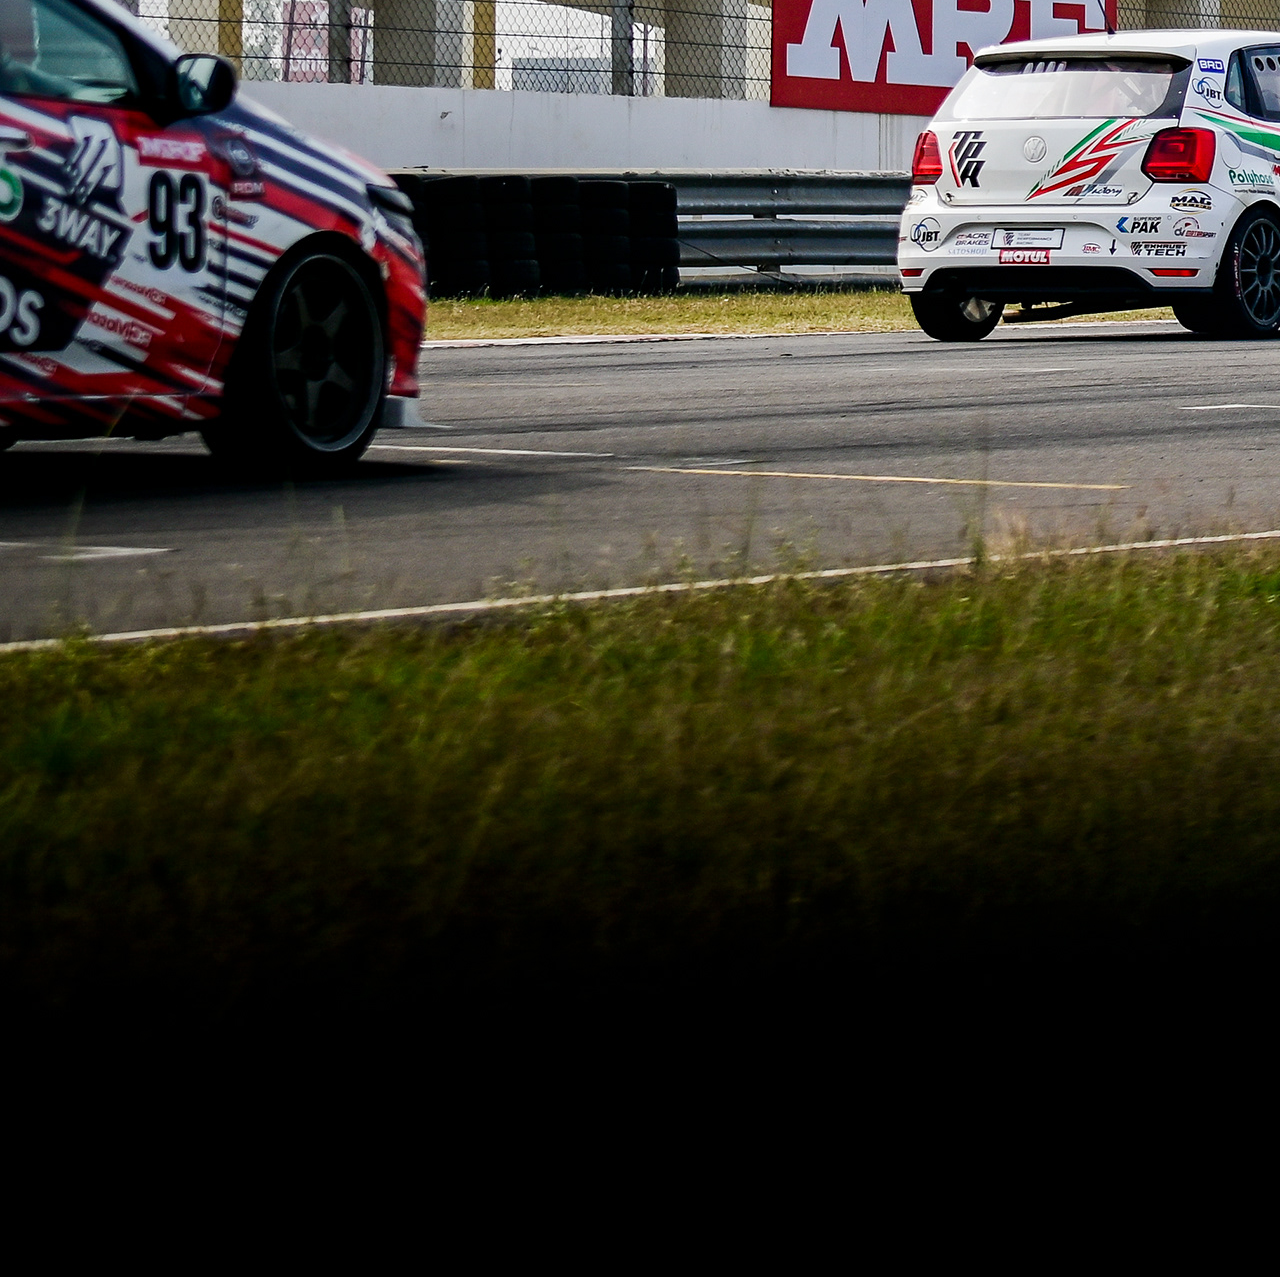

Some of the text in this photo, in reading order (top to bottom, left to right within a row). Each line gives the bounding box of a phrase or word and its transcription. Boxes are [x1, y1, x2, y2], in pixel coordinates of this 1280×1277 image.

[1205, 88, 1222, 100] JBT
[1228, 169, 1275, 187] Polyhose
[1171, 195, 1212, 206] MAG
[36, 195, 122, 258] 3WAY
[149, 170, 208, 273] 93
[1130, 222, 1162, 234] PAK
[921, 231, 941, 242] JBT
[1000, 250, 1048, 263] MOTUL
[1145, 249, 1187, 257] TECH
